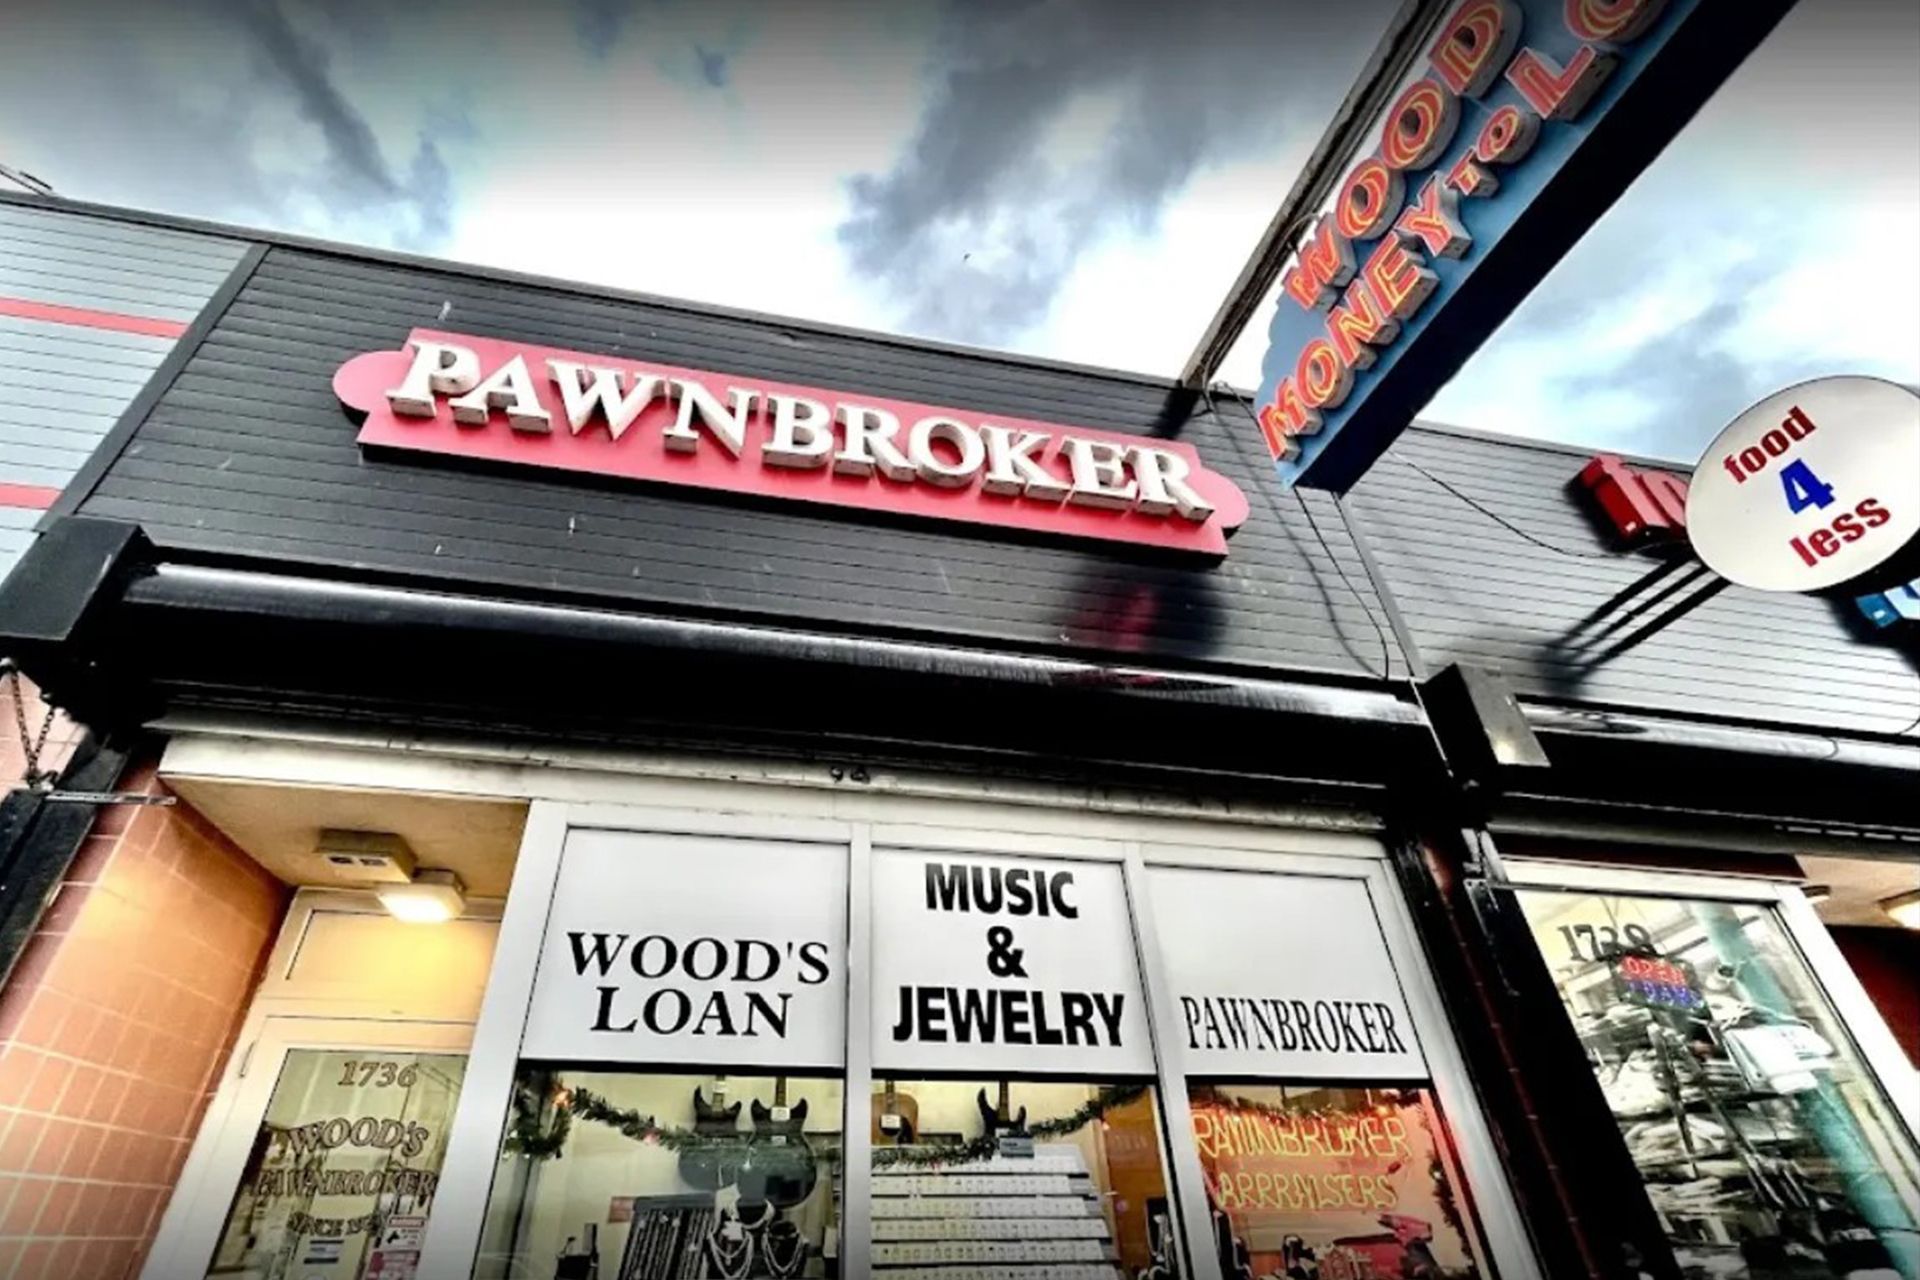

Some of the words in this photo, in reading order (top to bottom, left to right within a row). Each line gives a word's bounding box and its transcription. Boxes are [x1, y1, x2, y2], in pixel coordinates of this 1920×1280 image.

[1257, 171, 1458, 461] MONEY
[1445, 105, 1524, 197] TO
[387, 340, 1214, 522] PAWNBROKER
[1723, 405, 1816, 484] food
[1779, 458, 1836, 514] 4
[1789, 497, 1891, 567] less
[925, 862, 1078, 920] MUSIC
[567, 931, 831, 985] WOOD'S
[987, 925, 1028, 978] &
[590, 986, 794, 1039] LOAN
[893, 986, 1125, 1047] JEWELRY
[1180, 997, 1407, 1055] PAWNBROKER
[337, 1060, 420, 1088] 1736
[287, 1117, 430, 1157] WOOD'S
[254, 1168, 440, 1197] PAWNBROKER
